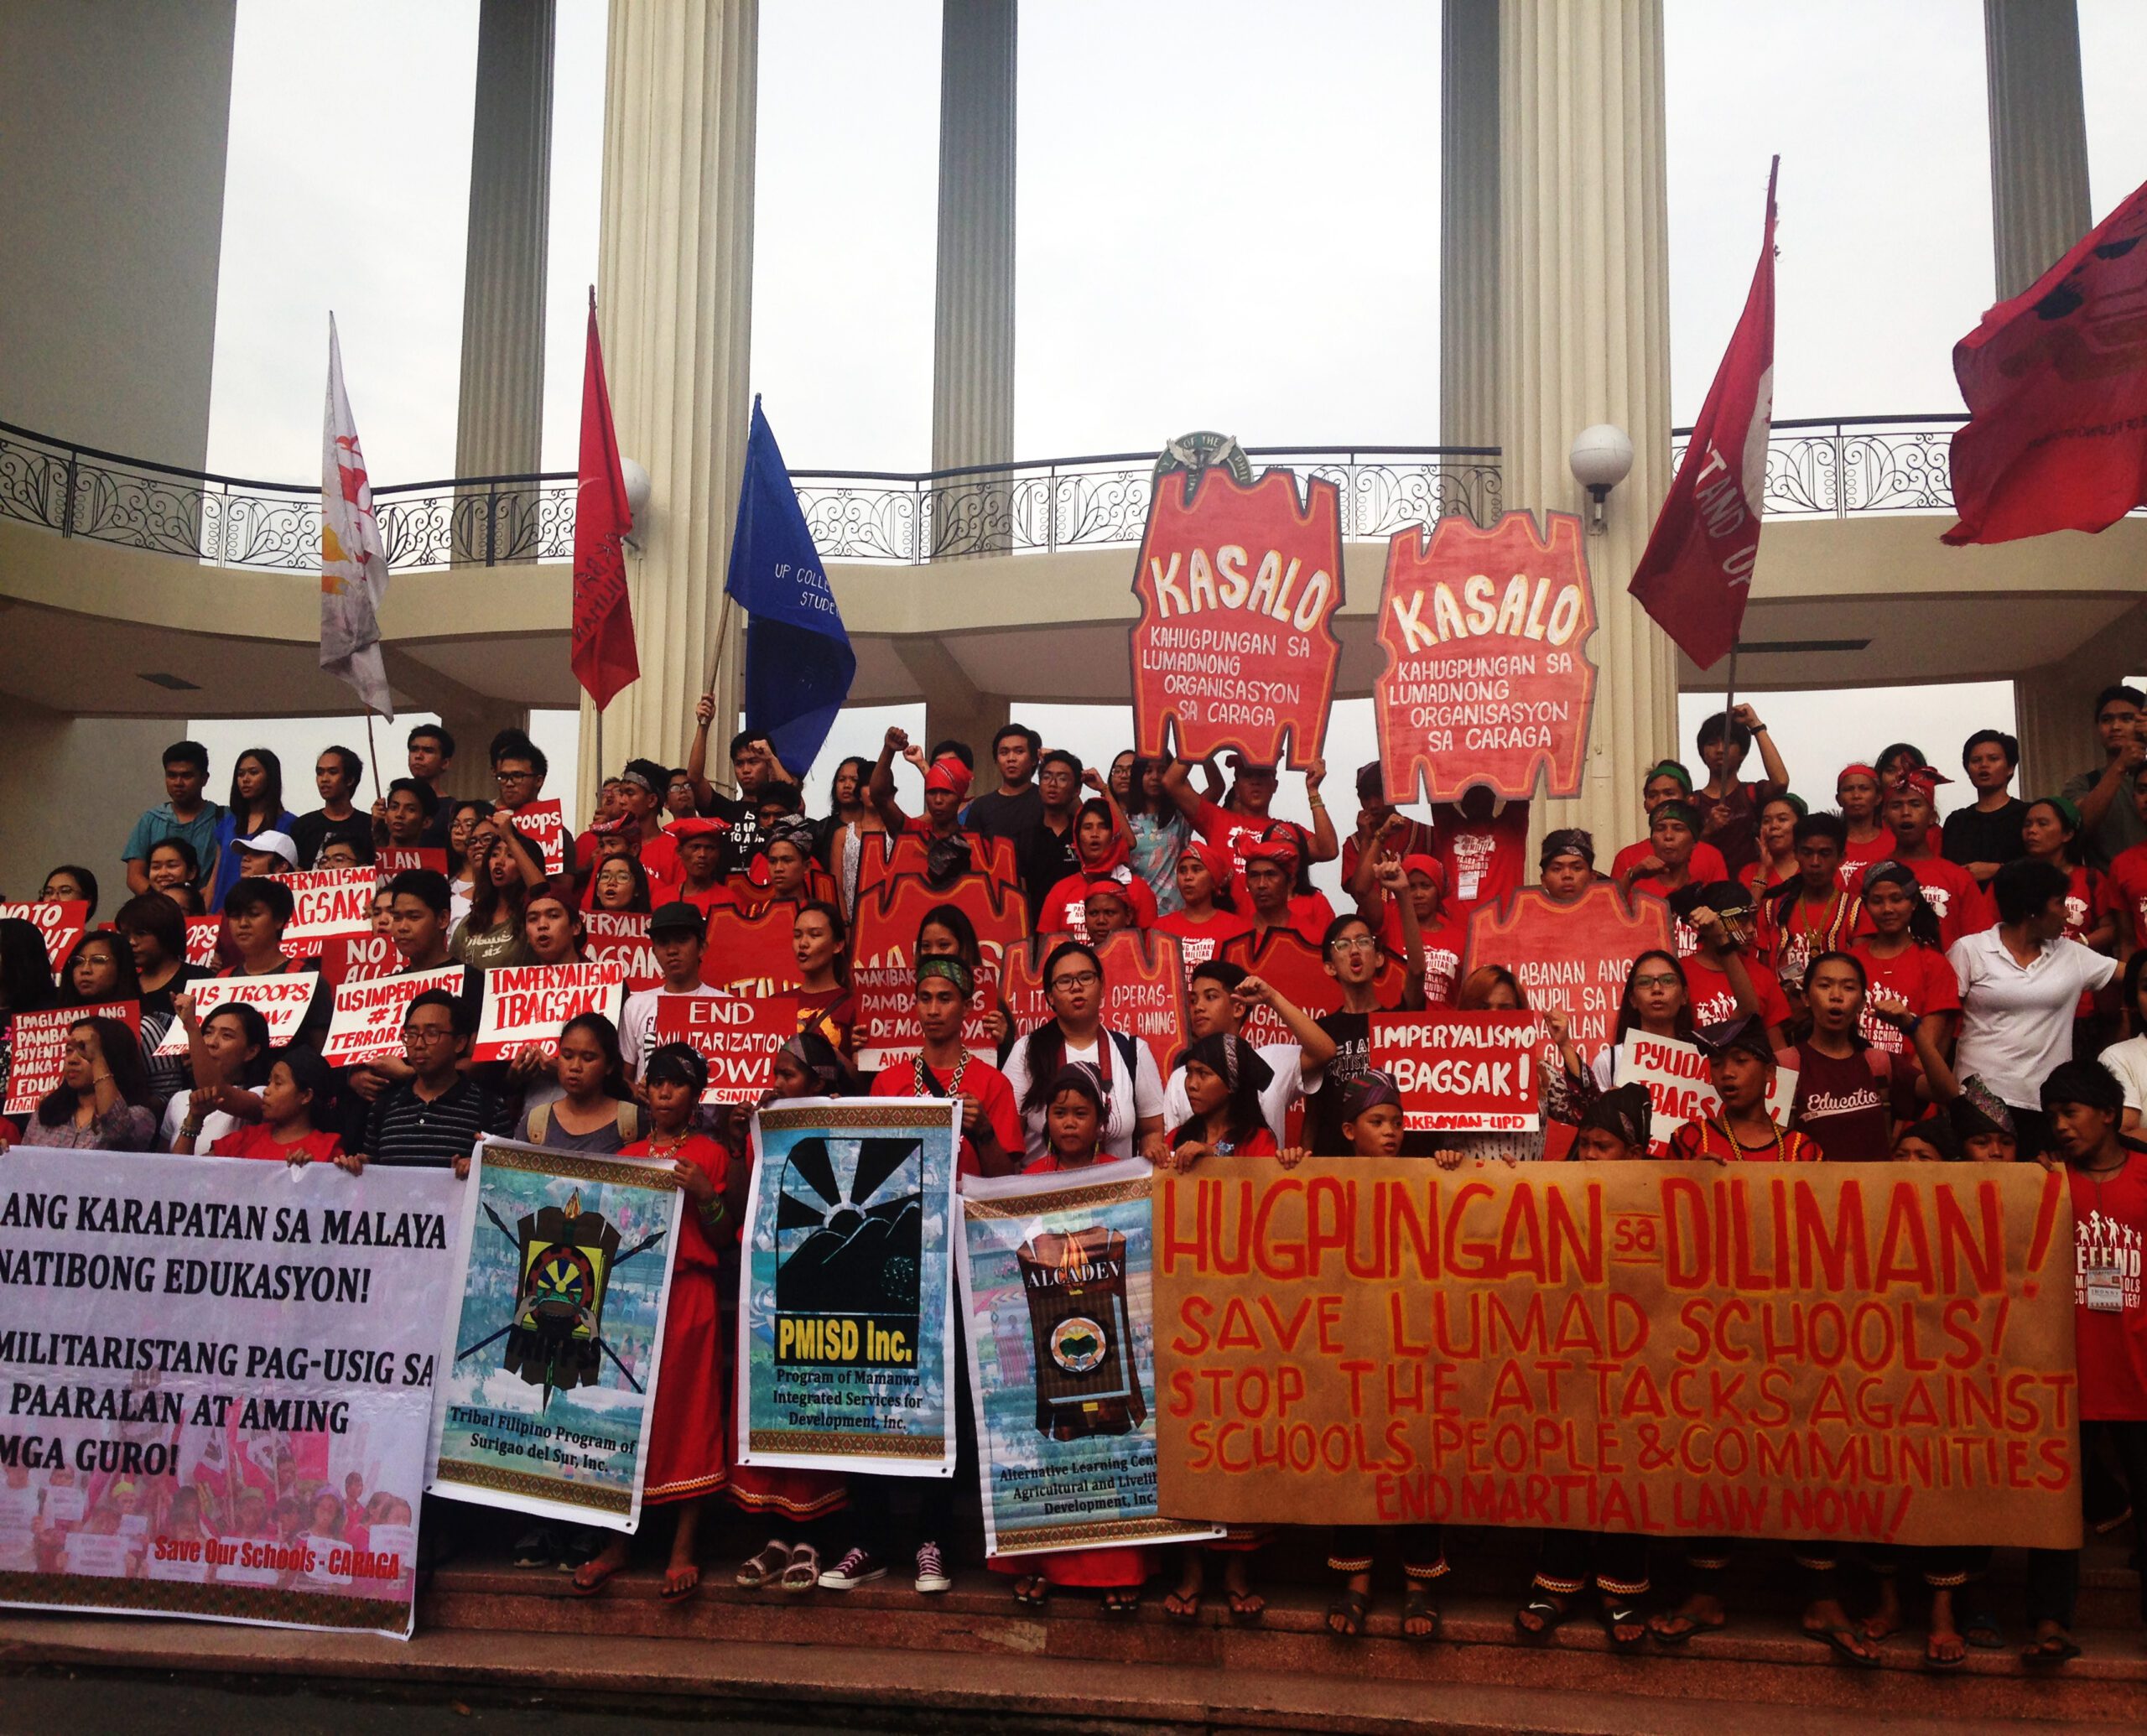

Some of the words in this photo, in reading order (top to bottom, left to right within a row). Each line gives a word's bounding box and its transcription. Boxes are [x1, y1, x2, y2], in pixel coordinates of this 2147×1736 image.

[1202, 436, 1219, 446] THE
[1696, 438, 1745, 539] TAND
[775, 564, 791, 579] UP
[1151, 545, 1331, 632] KASALO
[1392, 574, 1582, 652] KASALO
[1151, 626, 1276, 657] KAHUGPUNGAN
[1287, 636, 1310, 657] SA
[1143, 650, 1240, 676] LUMADNONG
[1399, 656, 1536, 683] KAHUGPUNGAN
[1547, 653, 1573, 673] SA
[1164, 678, 1299, 704] ORGANISASYON
[1389, 680, 1509, 705] LUMADNONG
[1177, 702, 1199, 721] SA
[1208, 704, 1275, 726] CARAGA
[1411, 702, 1567, 727] ORGANISASYON
[1428, 730, 1453, 751] SA
[1465, 725, 1552, 750] CARAGA
[512, 812, 561, 834] roops
[32, 903, 63, 928] TO
[346, 938, 387, 964] NO
[490, 962, 622, 995] IMPERYALISMO
[854, 969, 916, 988] MAKIBAK
[973, 969, 993, 985] SA
[1598, 959, 1633, 983] ANG
[228, 982, 309, 1004] TROOPS,
[337, 989, 364, 1011] US
[1009, 992, 1023, 1015] 1.
[1112, 984, 1173, 1009] OPERAS-
[1583, 986, 1606, 1011] SA
[367, 1003, 403, 1025] #1
[495, 986, 607, 1031] IBAGSAK!
[689, 1001, 755, 1025] END
[1137, 1011, 1177, 1036] AMING
[1373, 1023, 1535, 1050] IMPERYALISMO
[17, 1078, 63, 1096] EDUK
[1, 1193, 67, 1229] ANG
[76, 1197, 268, 1243] KARAPATAN
[273, 1208, 311, 1244] SA
[321, 1210, 446, 1250] MALAYA
[1163, 1177, 1603, 1284] HUGPUNGAN
[1614, 1218, 1656, 1254] sa
[164, 1259, 372, 1303] EDUKASYON!
[1027, 1259, 1123, 1289] ALCADEV
[779, 1318, 860, 1362] PMISD
[866, 1325, 913, 1364] Inc.
[1172, 1295, 1345, 1357] SAVE
[1391, 1290, 1650, 1360] LUMAD
[1677, 1296, 2009, 1375] SCHOOLS!
[245, 1345, 393, 1385] PAG-USIG
[403, 1353, 434, 1387] SA
[777, 1369, 834, 1388] Program
[837, 1369, 853, 1385] of
[854, 1370, 921, 1388] Mamanwa
[8, 1383, 184, 1427] PAARALAN
[192, 1395, 232, 1427] AT
[239, 1398, 349, 1434] AMING
[772, 1390, 842, 1410] Integrated
[845, 1391, 902, 1410] Services
[904, 1394, 923, 1410] for
[1170, 1365, 1305, 1418] STOP
[1340, 1360, 1461, 1418] THE
[1489, 1358, 1793, 1427] ATTACKS
[1809, 1370, 2077, 1433] AGAINST
[450, 1406, 495, 1431] Tribal
[498, 1414, 552, 1438] Filipino
[555, 1426, 616, 1452] Program
[621, 1440, 637, 1454] of
[788, 1411, 880, 1431] Development,
[882, 1414, 907, 1431] Inc.
[75, 1440, 179, 1476] GURO!
[470, 1432, 524, 1458] Surigao
[528, 1444, 549, 1462] del
[553, 1448, 580, 1468] Sur,
[583, 1454, 609, 1473] Inc.
[1433, 1417, 1624, 1474] PEOPLE
[1639, 1424, 1676, 1471] &
[1681, 1426, 2072, 1490] COMMUNITIES
[999, 1465, 1069, 1483] Alternative
[1071, 1458, 1129, 1477] Learning
[1013, 1479, 1089, 1502] Agricultural
[1092, 1477, 1116, 1491] and
[1044, 1493, 1131, 1515] Development,
[1135, 1490, 1157, 1506] Inc.
[1376, 1474, 1453, 1521] END
[1462, 1474, 1666, 1531] MARTIAL
[1675, 1482, 1768, 1531] LAW
[1782, 1484, 1914, 1544] NOW!
[153, 1535, 200, 1563] Save
[205, 1537, 237, 1567] Our
[241, 1541, 315, 1572] Schools
[328, 1549, 399, 1580] CARAGA
